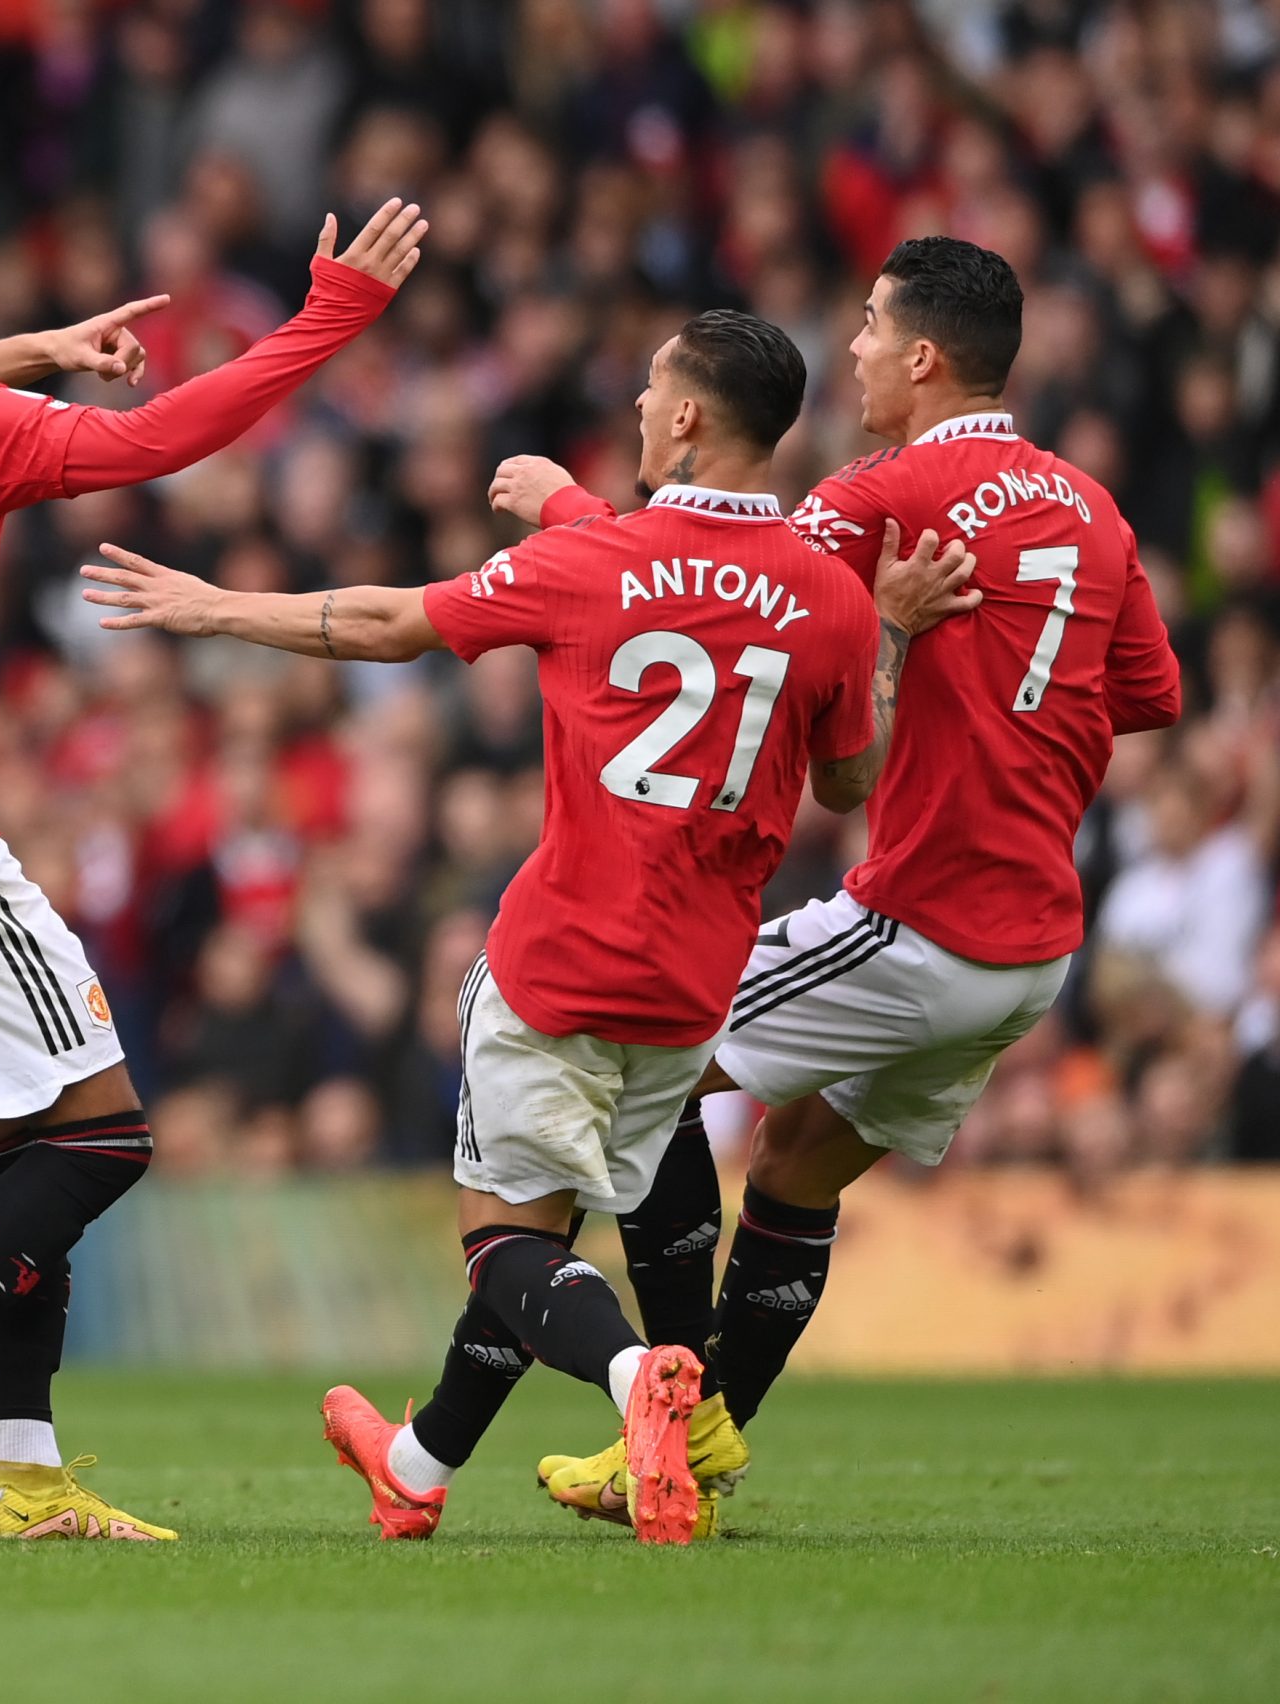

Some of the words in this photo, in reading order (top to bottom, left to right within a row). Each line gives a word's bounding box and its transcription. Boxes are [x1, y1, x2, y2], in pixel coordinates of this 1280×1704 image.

[947, 468, 1092, 539] RONALDO
[620, 557, 810, 632] ANTONY
[1011, 545, 1079, 712] 7
[599, 629, 791, 813] 21
